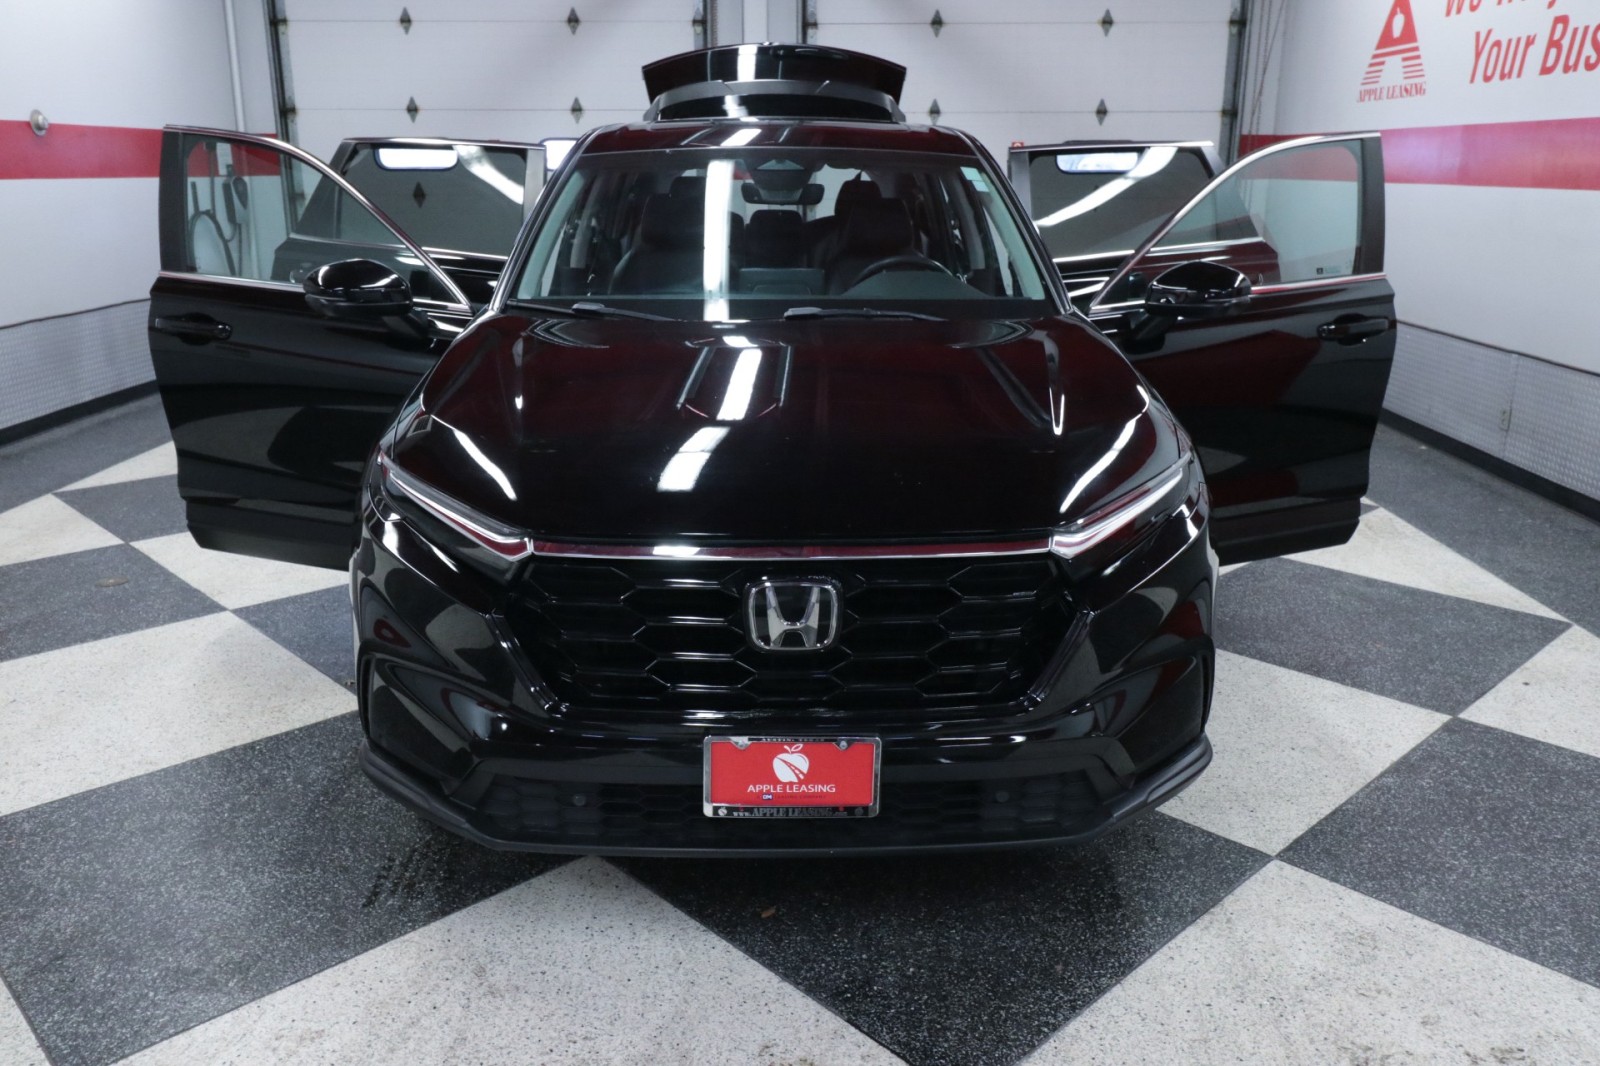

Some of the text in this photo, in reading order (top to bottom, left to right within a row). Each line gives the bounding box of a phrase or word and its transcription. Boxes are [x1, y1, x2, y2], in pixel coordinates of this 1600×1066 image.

[1469, 14, 1600, 84] Your Bus
[1356, 81, 1427, 103] APPLE LEASING
[747, 784, 836, 793] APPLE LEASING
